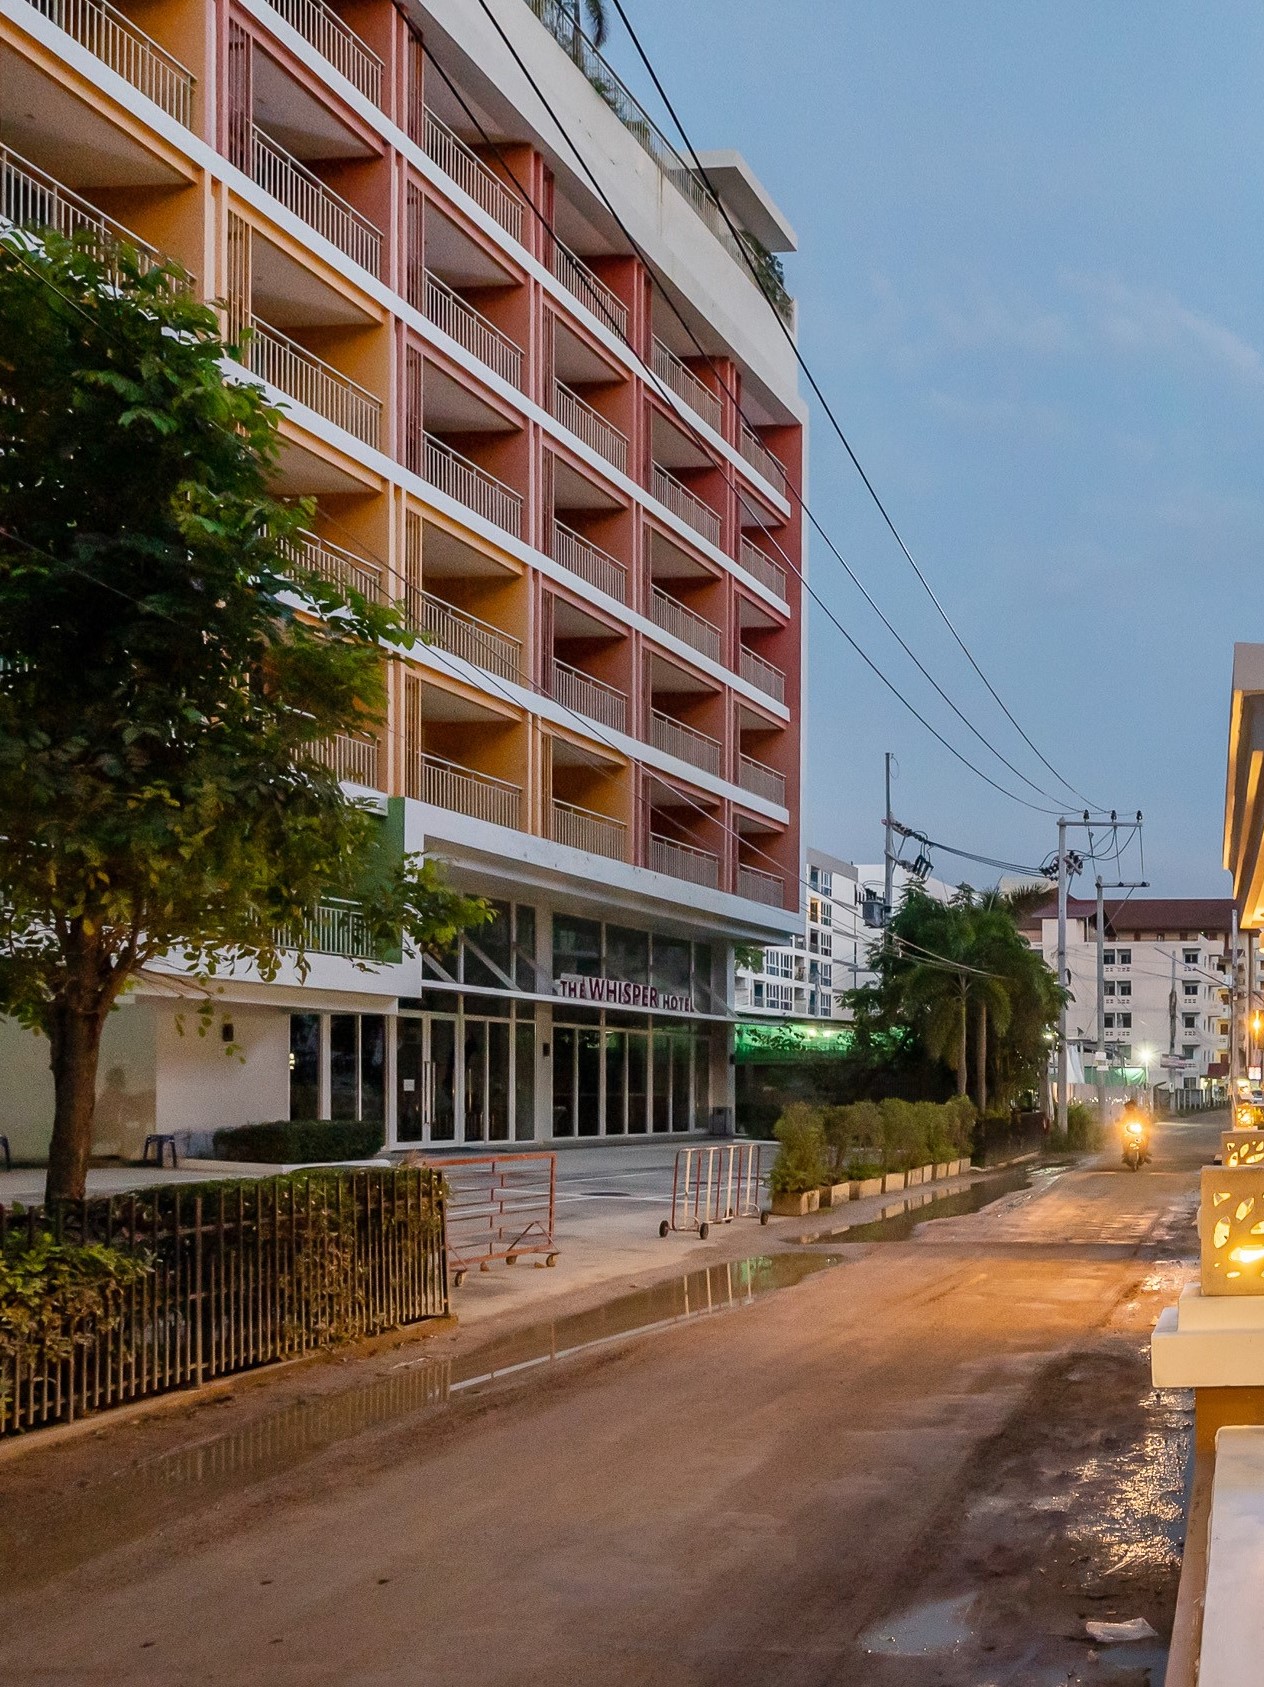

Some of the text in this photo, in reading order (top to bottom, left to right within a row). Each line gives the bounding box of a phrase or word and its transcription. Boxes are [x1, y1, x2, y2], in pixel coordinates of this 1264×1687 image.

[560, 977, 695, 1013] THE WHISPER HOTEL
